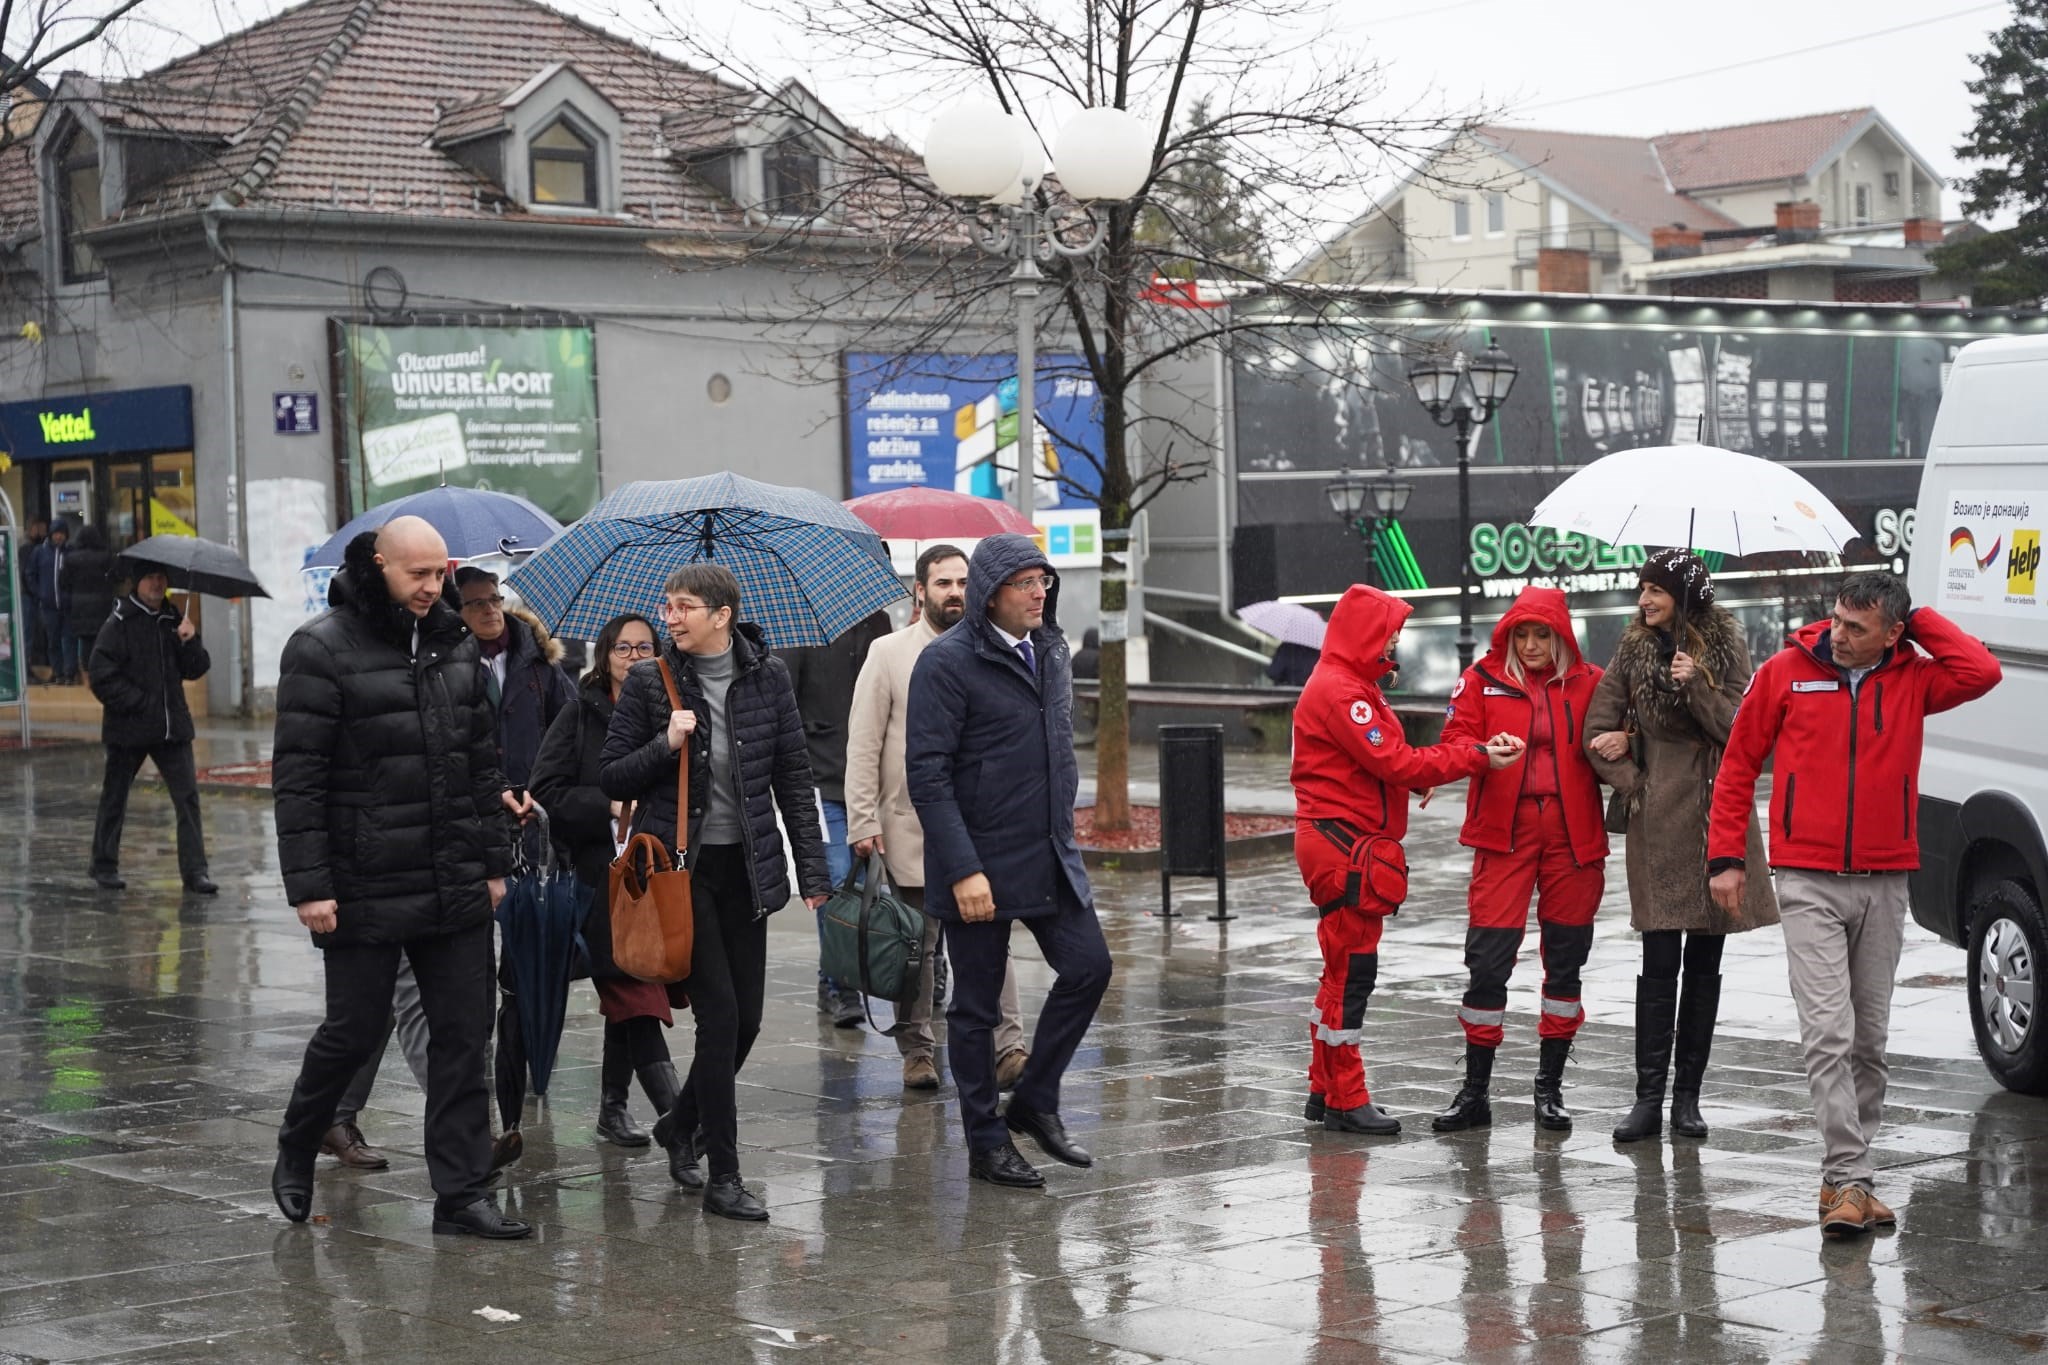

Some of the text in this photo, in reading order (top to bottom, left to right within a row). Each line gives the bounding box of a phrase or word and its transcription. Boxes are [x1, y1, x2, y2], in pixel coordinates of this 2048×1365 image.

[391, 371, 554, 394] UNIVEREXPORT
[39, 408, 95, 443] Yettel.
[1953, 500, 2029, 520] Возило је донација
[2007, 539, 2041, 580] Help
